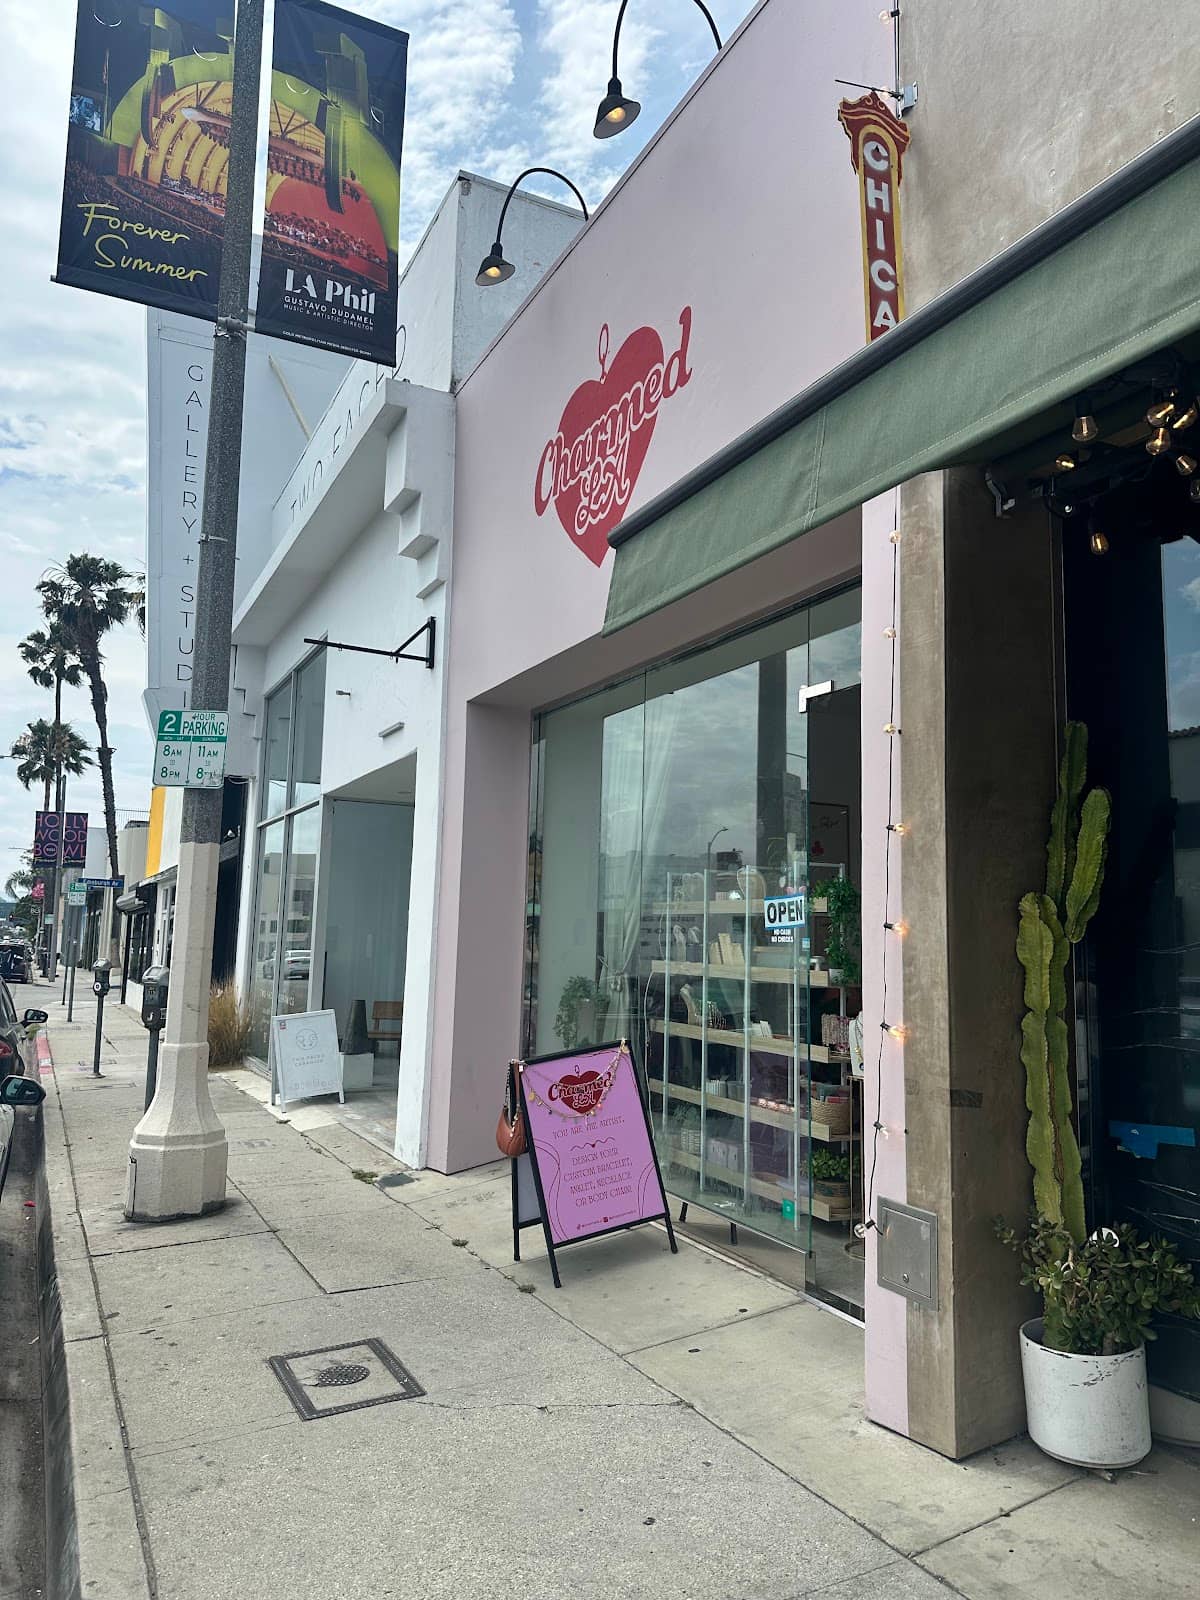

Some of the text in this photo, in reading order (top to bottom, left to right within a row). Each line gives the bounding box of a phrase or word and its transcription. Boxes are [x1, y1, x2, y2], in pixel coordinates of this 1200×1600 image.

[77, 203, 190, 244] Forever
[94, 233, 208, 281] Summer
[285, 268, 375, 314] LA Phil
[283, 303, 304, 313] MUSIC
[313, 312, 341, 323] ARTISTIC
[343, 319, 374, 331] DIRECTOR
[284, 295, 374, 325] GUSTAVO DUDAMEL
[534, 305, 692, 517] Charmed
[182, 365, 203, 533] GALLERY
[163, 713, 216, 732] 2 HOUR
[183, 721, 225, 735] PARKING
[35, 813, 88, 829] HOLLY
[35, 829, 87, 843] WOOD
[33, 842, 86, 858] BOWL
[767, 899, 803, 923] OPEN
[552, 1129, 569, 1140] YOU
[570, 1125, 583, 1136] ARE
[572, 1147, 618, 1166] DESIGN YOUR
[563, 1167, 596, 1181] CUSTOM
[596, 1171, 632, 1187] NECKLACE
[575, 1197, 587, 1207] OR
[587, 1191, 608, 1204] BODY
